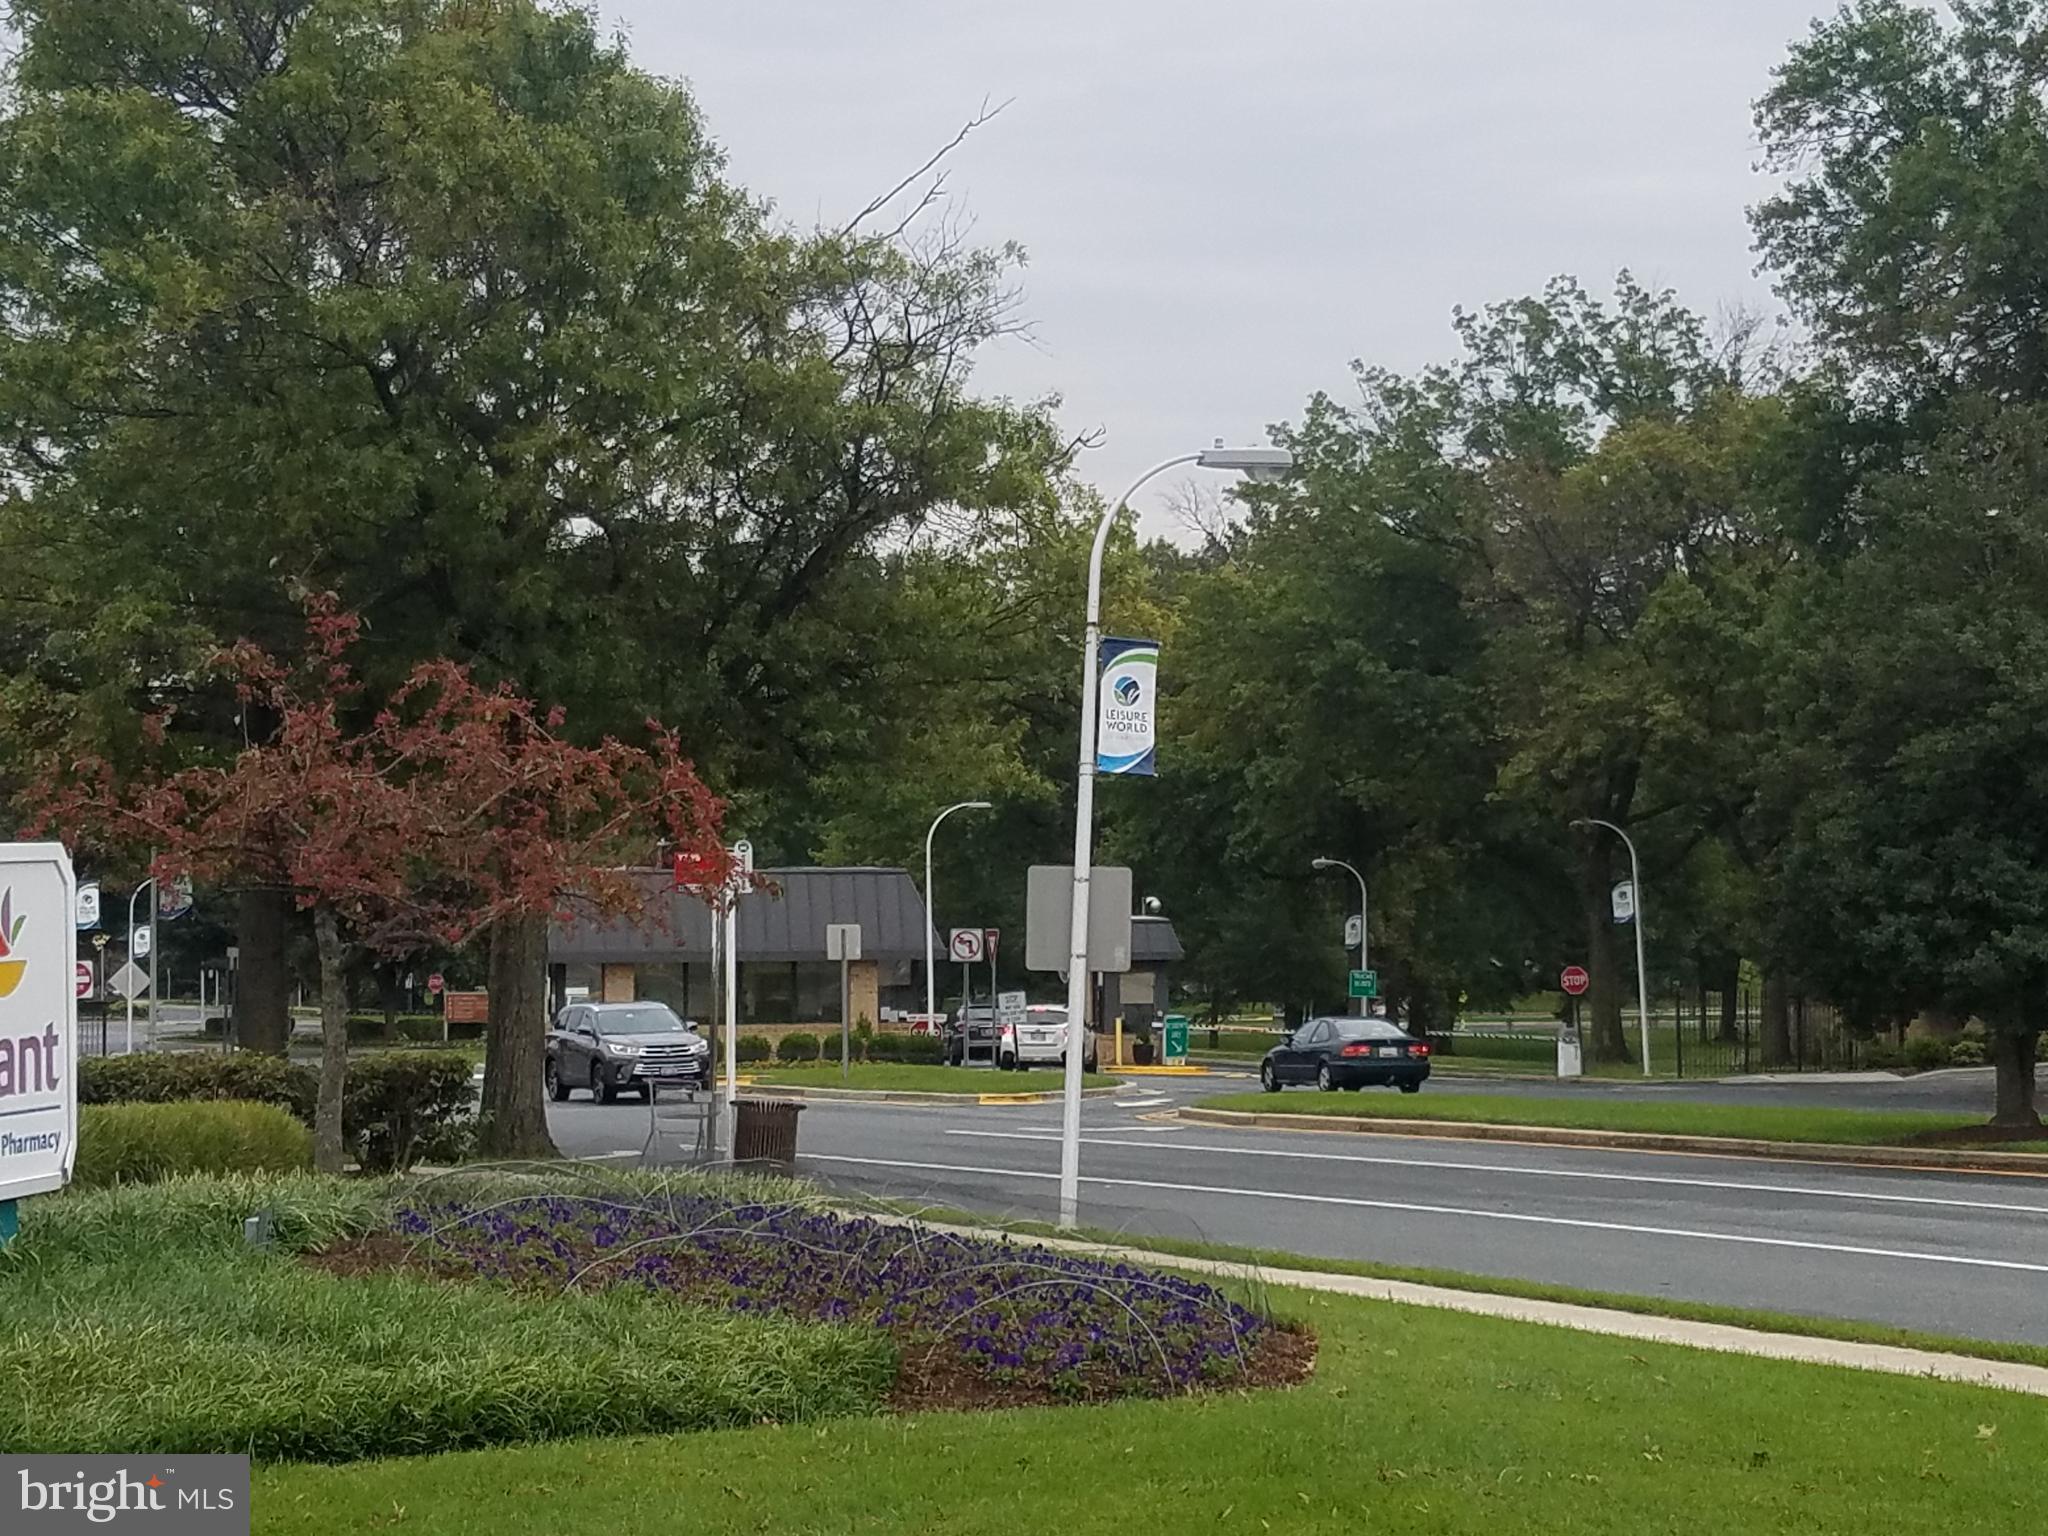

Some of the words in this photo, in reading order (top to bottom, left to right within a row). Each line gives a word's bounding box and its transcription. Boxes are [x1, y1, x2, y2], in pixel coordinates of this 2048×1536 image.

[1105, 709, 1148, 722] LEISURE
[1106, 721, 1148, 733] WORLD
[1563, 975, 1586, 986] STOP
[1, 1130, 62, 1157] Pharmacy
